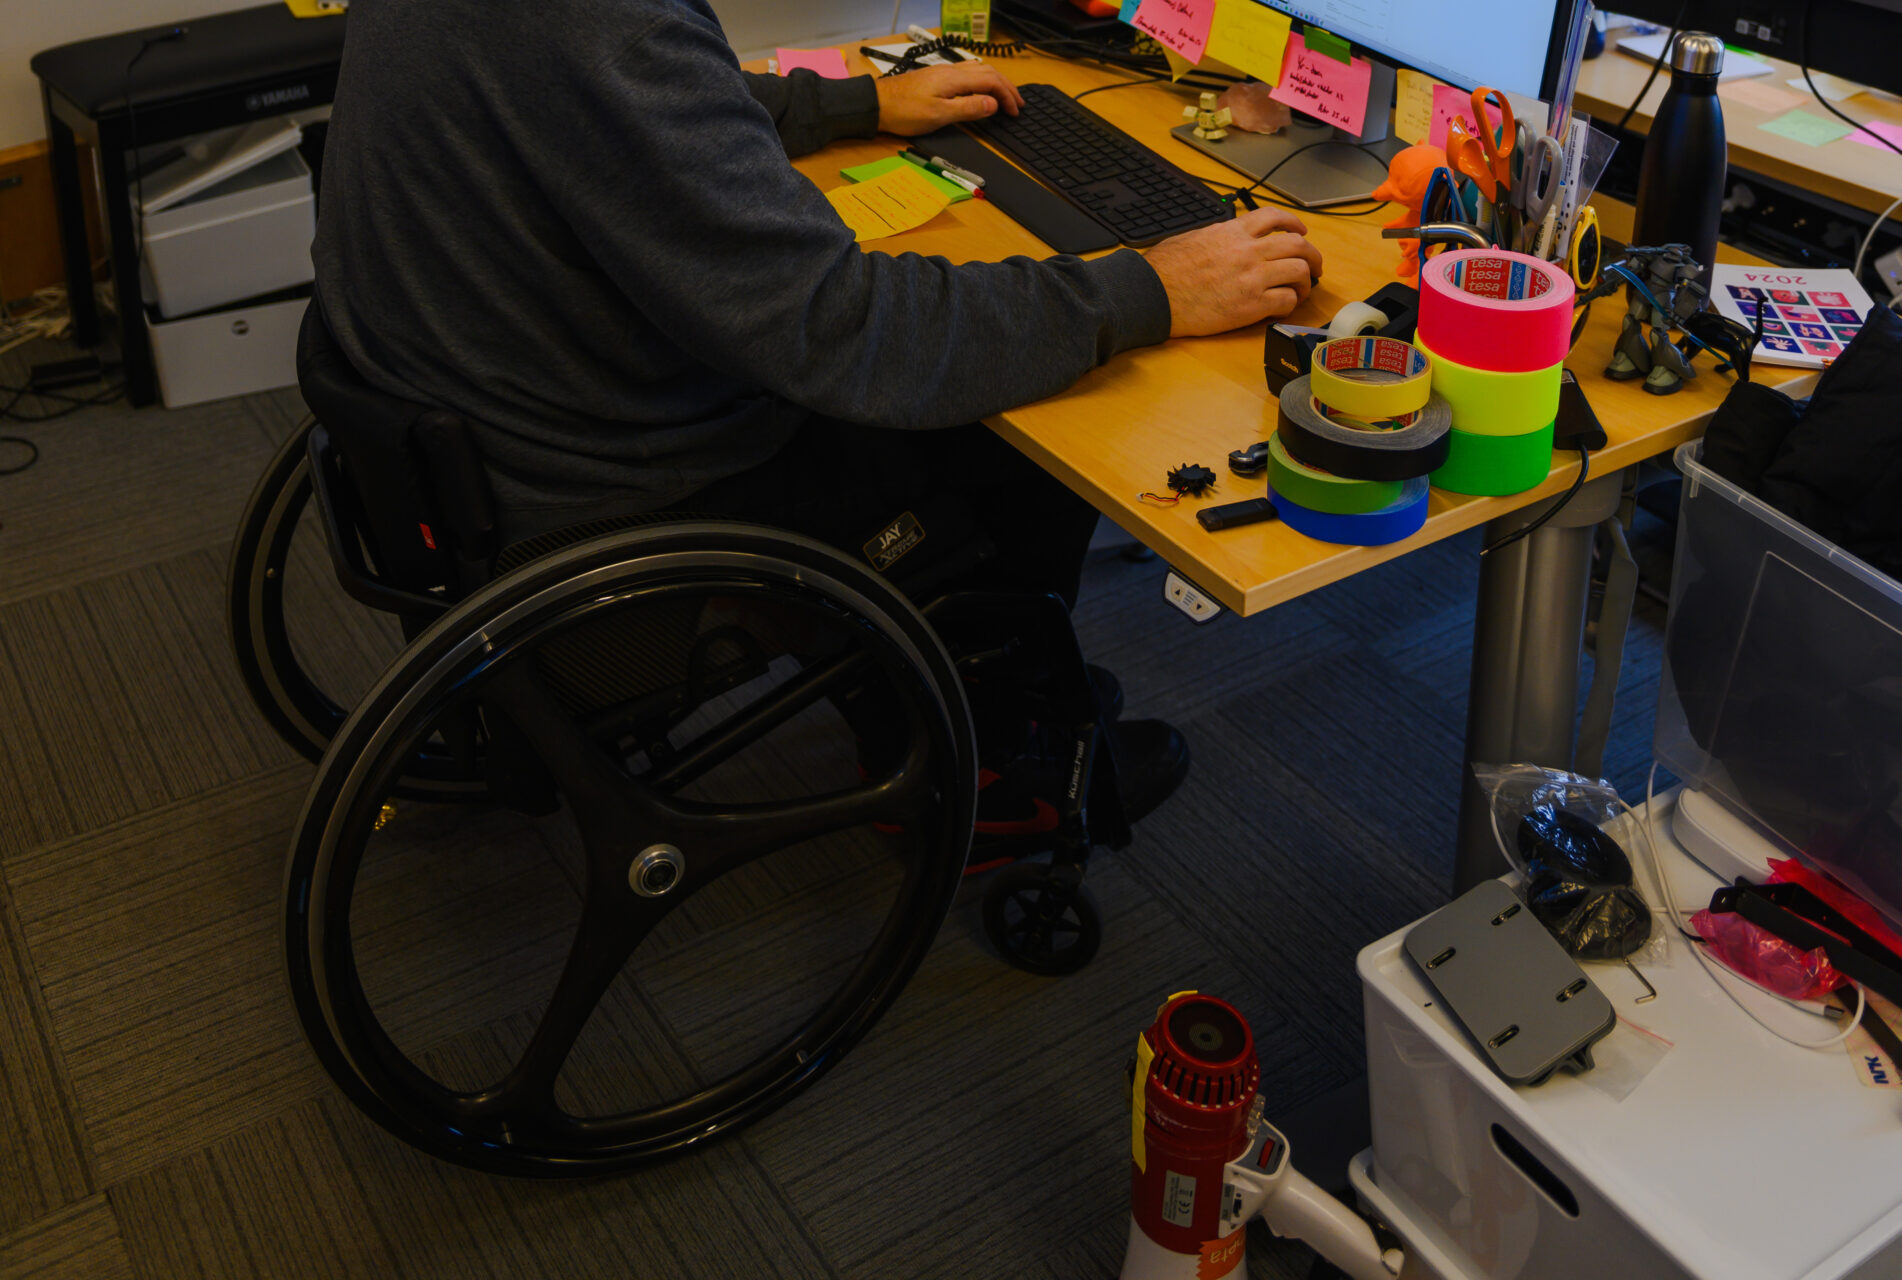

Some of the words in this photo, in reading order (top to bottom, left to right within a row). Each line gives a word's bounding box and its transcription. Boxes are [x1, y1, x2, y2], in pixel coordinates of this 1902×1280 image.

[261, 84, 310, 107] YAMAHA
[1469, 258, 1503, 269] tesa
[1469, 269, 1503, 281] tesa
[1745, 273, 1807, 286] 2024
[1467, 280, 1501, 293] tesa
[1380, 340, 1405, 353] tesa
[1379, 348, 1404, 361] tesa
[1280, 357, 1299, 374] Scotch
[1329, 356, 1354, 367] tesa
[1378, 357, 1403, 370] tesa
[879, 523, 901, 550] JAY
